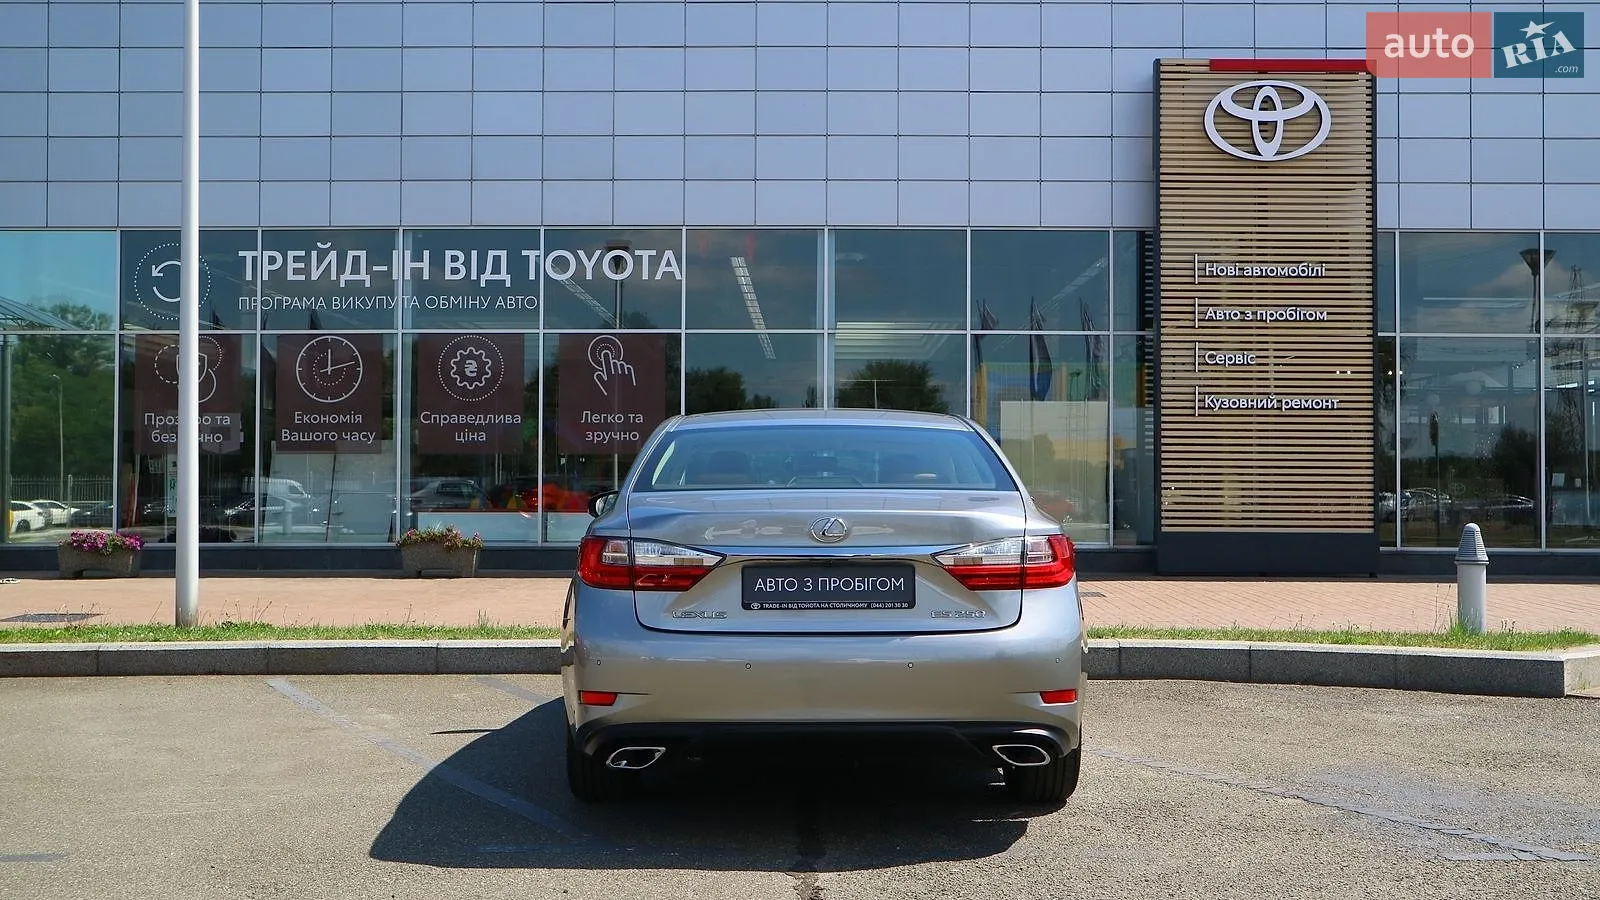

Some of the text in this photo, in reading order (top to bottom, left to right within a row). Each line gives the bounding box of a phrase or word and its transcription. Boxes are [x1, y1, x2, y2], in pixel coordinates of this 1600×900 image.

[238, 242, 683, 288] ТРЕЙД-ІН ВІД TOYOTA
[1205, 262, 1326, 277] Нові автомобілі
[238, 295, 538, 310] ПРОГРАМА ВИКУПУ ТА ОБМІНУ АВТО
[1205, 307, 1328, 323] Авто з пробігом
[1205, 351, 1257, 367] Сервіс
[1205, 393, 1340, 412] Кузовний ремонт
[215, 415, 231, 425] та
[294, 411, 363, 424] Економія
[420, 411, 521, 427] Справедлива
[580, 410, 644, 424] Легко та
[281, 428, 376, 444] Вашого часу
[455, 428, 487, 444] ціна
[585, 430, 640, 444] зручно
[754, 577, 905, 592] АВТО З ПРОБІГОМ
[672, 610, 728, 620] LEXUS
[930, 610, 986, 619] ES 250
